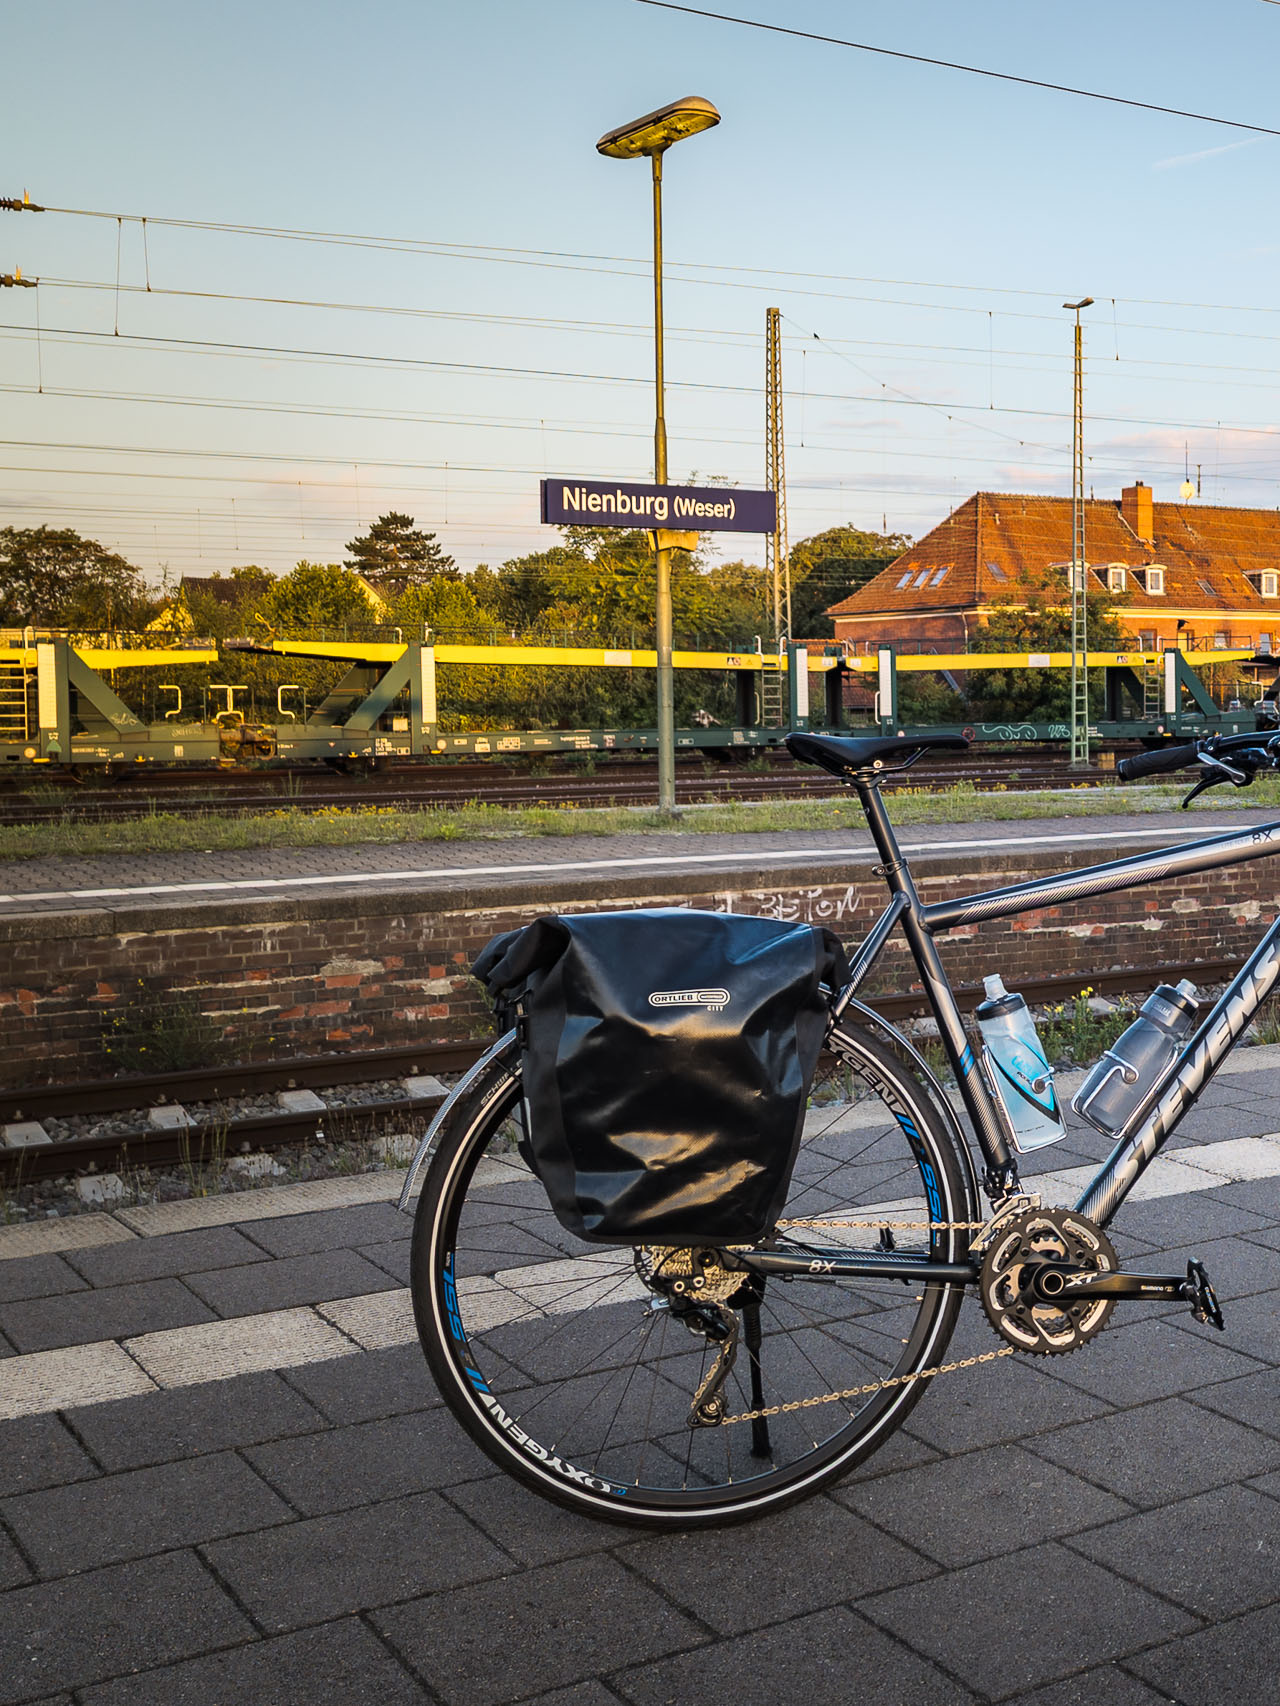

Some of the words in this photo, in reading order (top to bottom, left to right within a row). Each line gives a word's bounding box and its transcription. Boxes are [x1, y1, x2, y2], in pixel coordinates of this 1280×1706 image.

[562, 486, 669, 521] Nienburg
[673, 495, 736, 520] (Weser)
[1251, 830, 1274, 845] 8X
[654, 993, 694, 1003] ORTLIEB
[706, 1004, 724, 1012] CITY
[828, 1037, 901, 1106] YGEN
[1112, 943, 1280, 1203] STEVENS
[808, 1259, 837, 1274] 8X
[442, 1252, 467, 1343] SSL
[490, 1402, 611, 1494] OXYGEN
